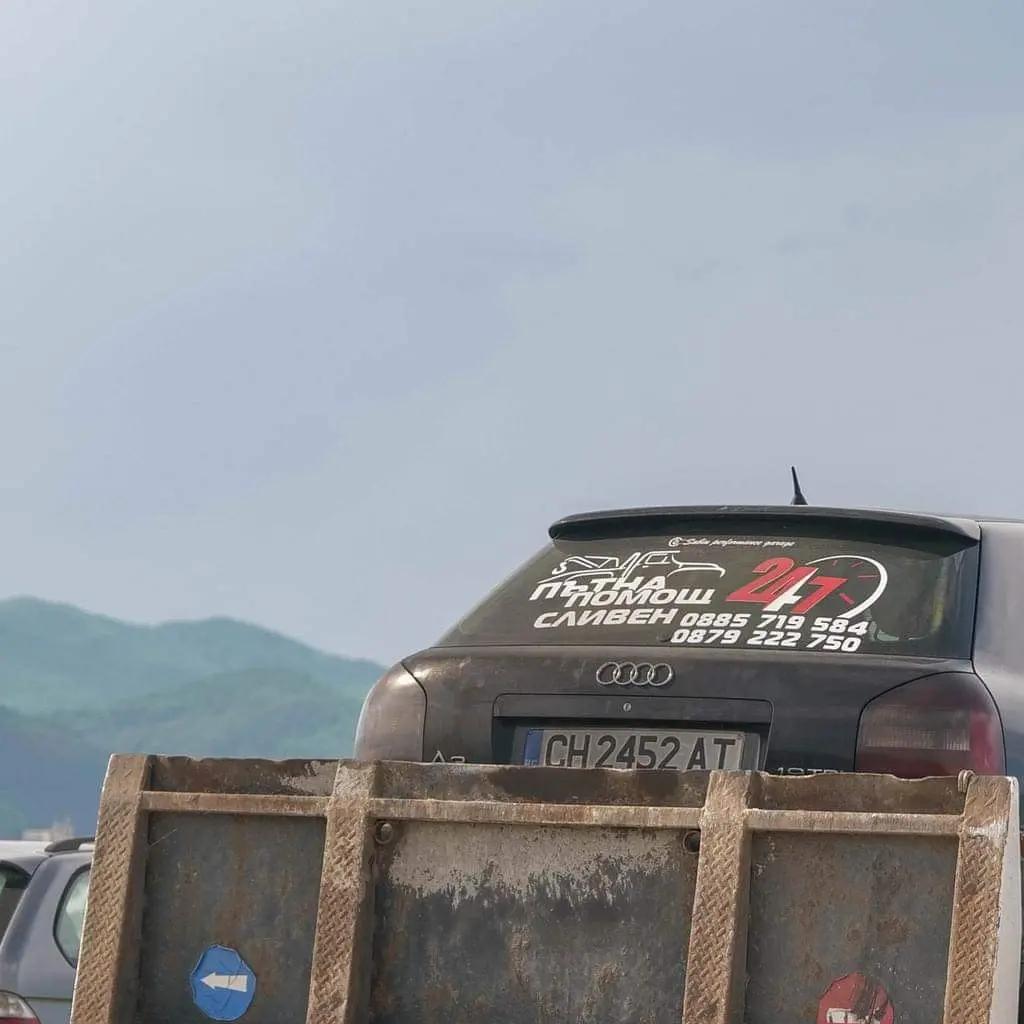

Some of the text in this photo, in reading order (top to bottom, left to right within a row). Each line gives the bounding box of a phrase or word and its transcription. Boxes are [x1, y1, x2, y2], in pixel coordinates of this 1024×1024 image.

[529, 575, 666, 601] ПЪТНА
[533, 608, 680, 629] СЛИВЕН
[679, 613, 870, 637] 0885 719 584
[669, 628, 863, 653] 0879 222 750
